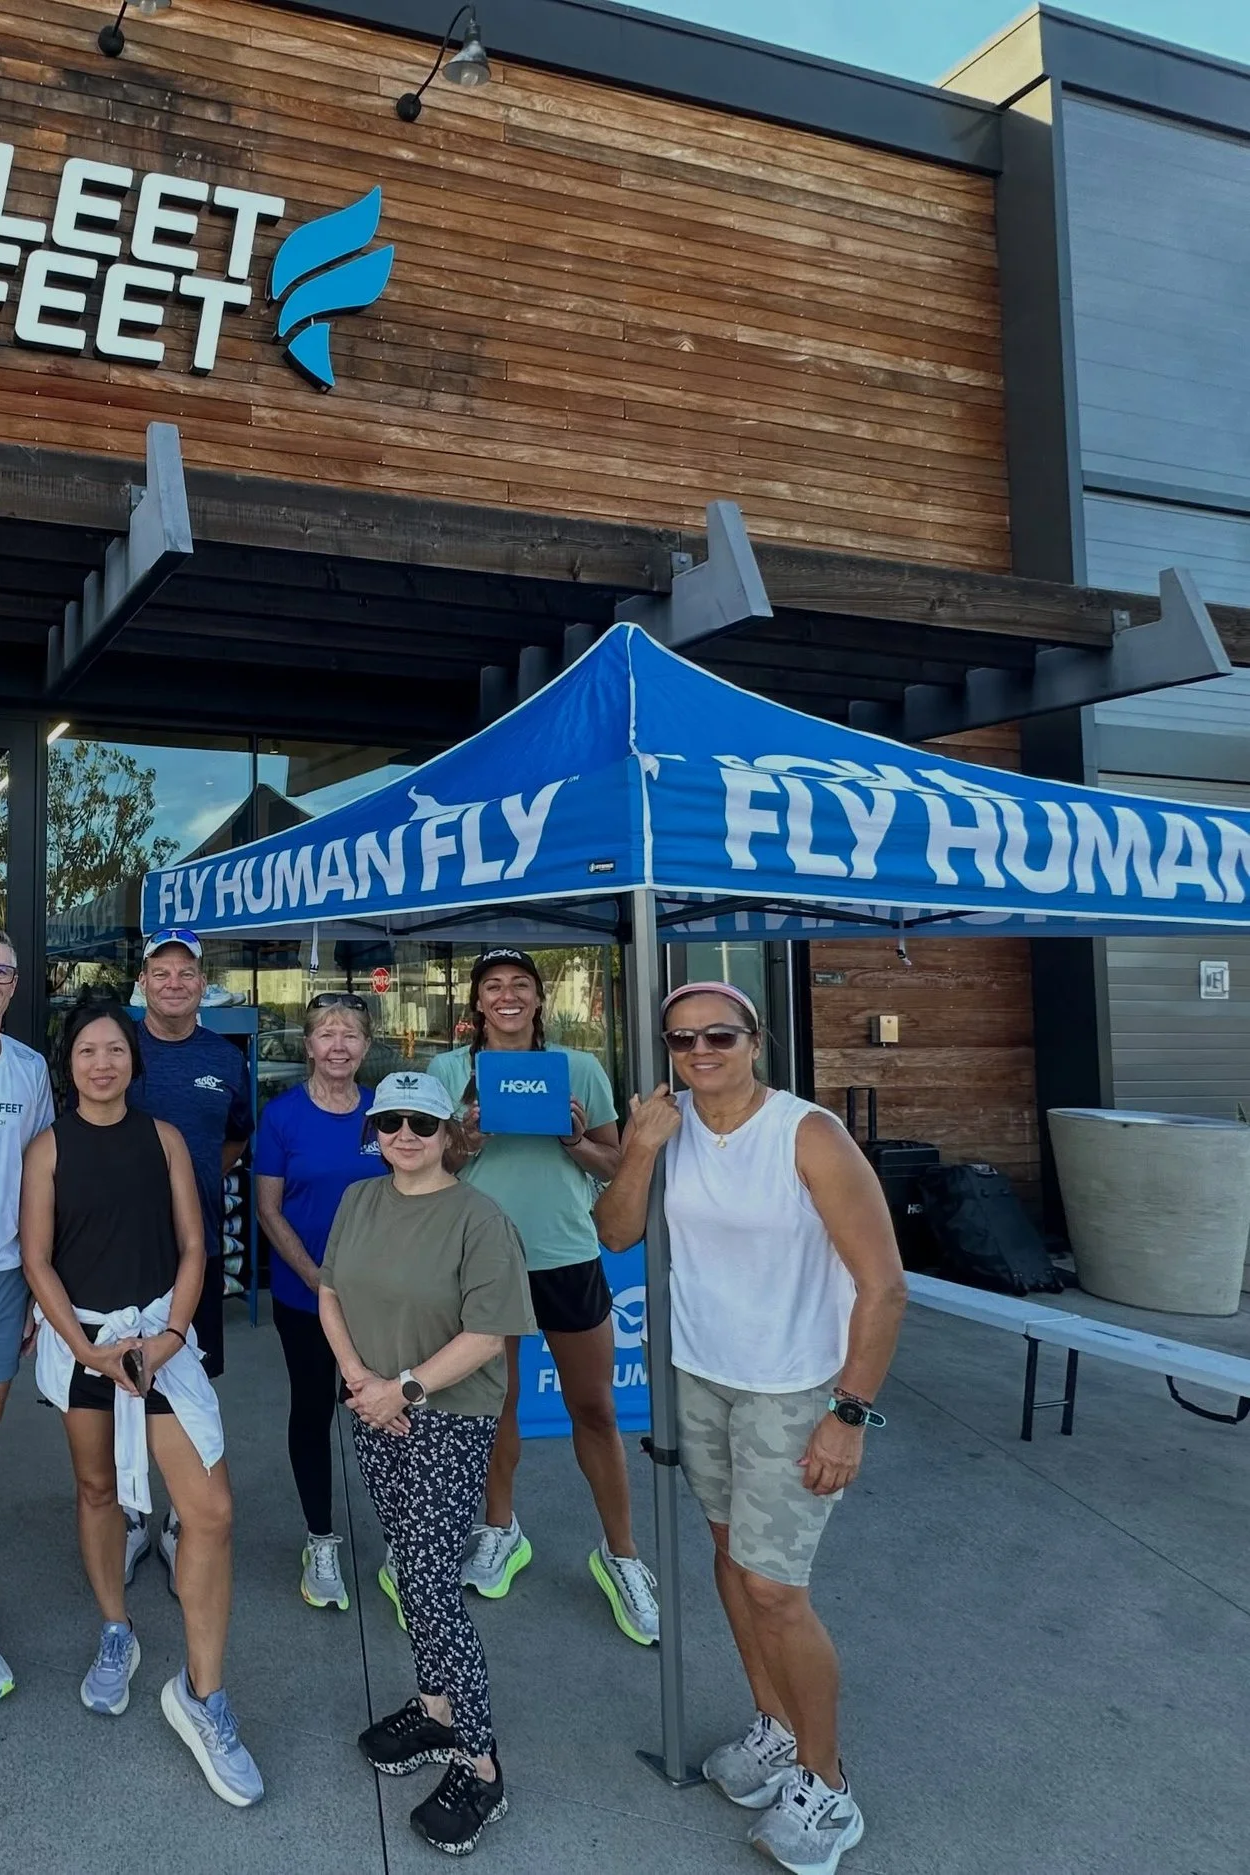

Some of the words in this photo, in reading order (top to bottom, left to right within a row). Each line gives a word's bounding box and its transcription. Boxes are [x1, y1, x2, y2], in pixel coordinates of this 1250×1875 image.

[158, 866, 216, 924] FLY
[215, 822, 405, 914] HUMAN
[421, 779, 568, 893] FLY
[718, 768, 896, 879] FLY
[482, 949, 523, 962] HOKA
[499, 1080, 548, 1094] HOKA
